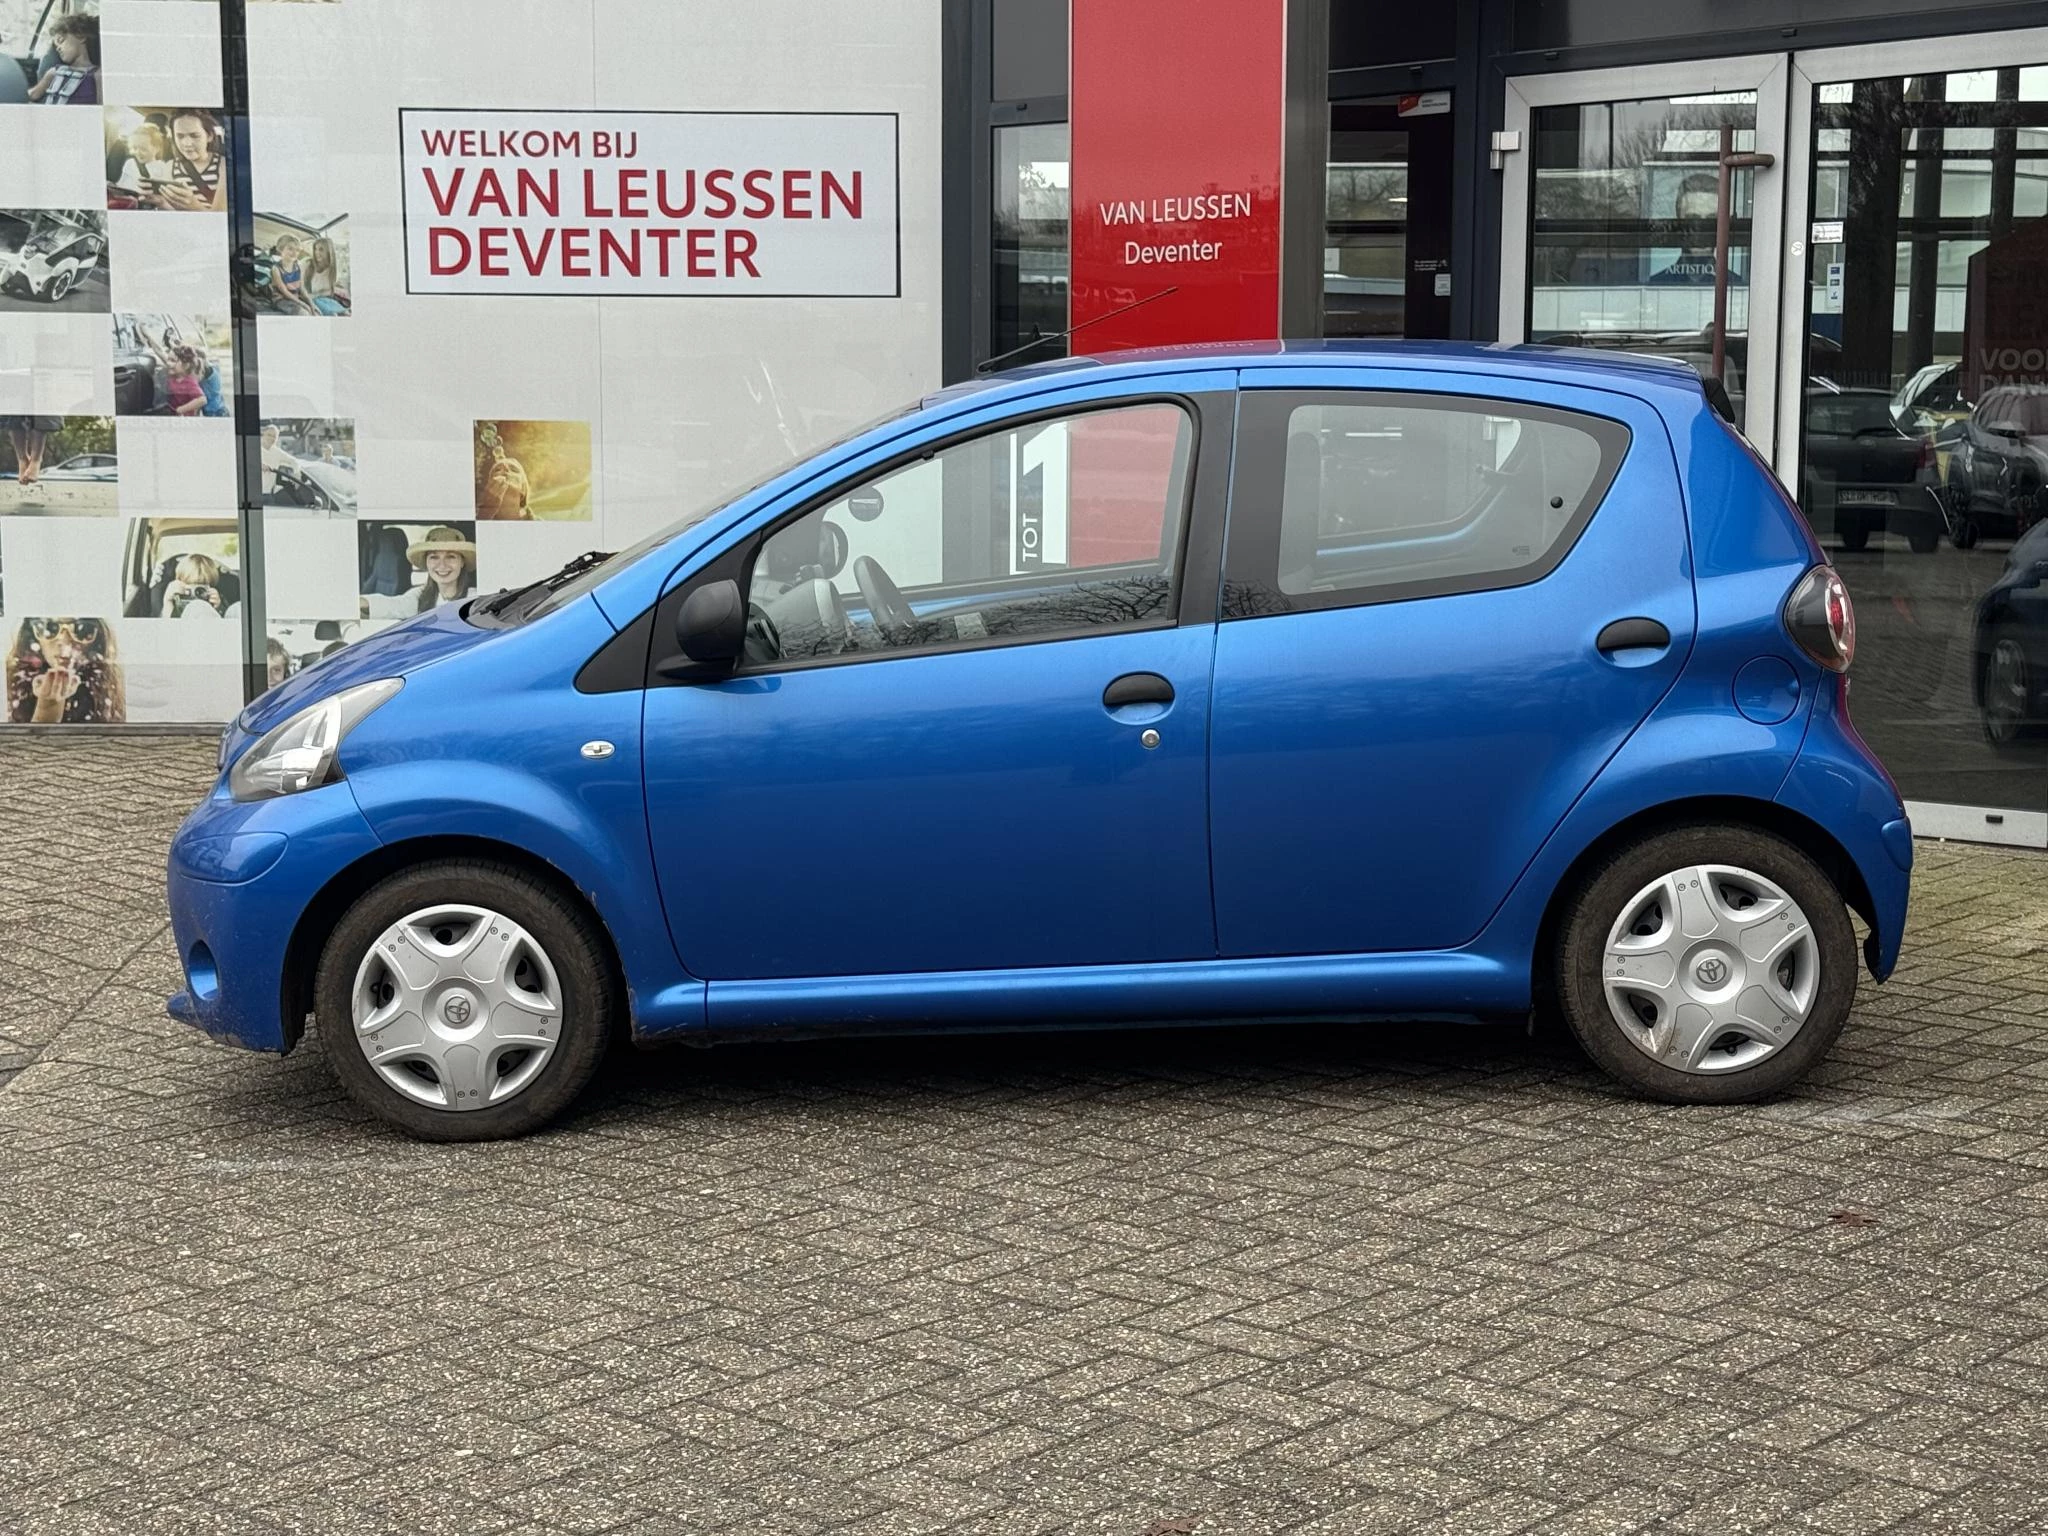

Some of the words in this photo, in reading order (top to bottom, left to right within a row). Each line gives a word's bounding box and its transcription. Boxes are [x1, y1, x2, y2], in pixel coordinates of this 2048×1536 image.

[421, 130, 581, 158] WELKOM
[592, 130, 637, 157] BIJ
[423, 168, 561, 217] VAN
[583, 169, 863, 219] LEUSSEN
[1101, 202, 1145, 225] VAN
[1152, 194, 1251, 224] LEUSSEN
[429, 227, 759, 277] DEVENTER
[1125, 239, 1223, 265] Deventer
[1979, 347, 2048, 372] VOO
[1022, 513, 1038, 562] TOT
